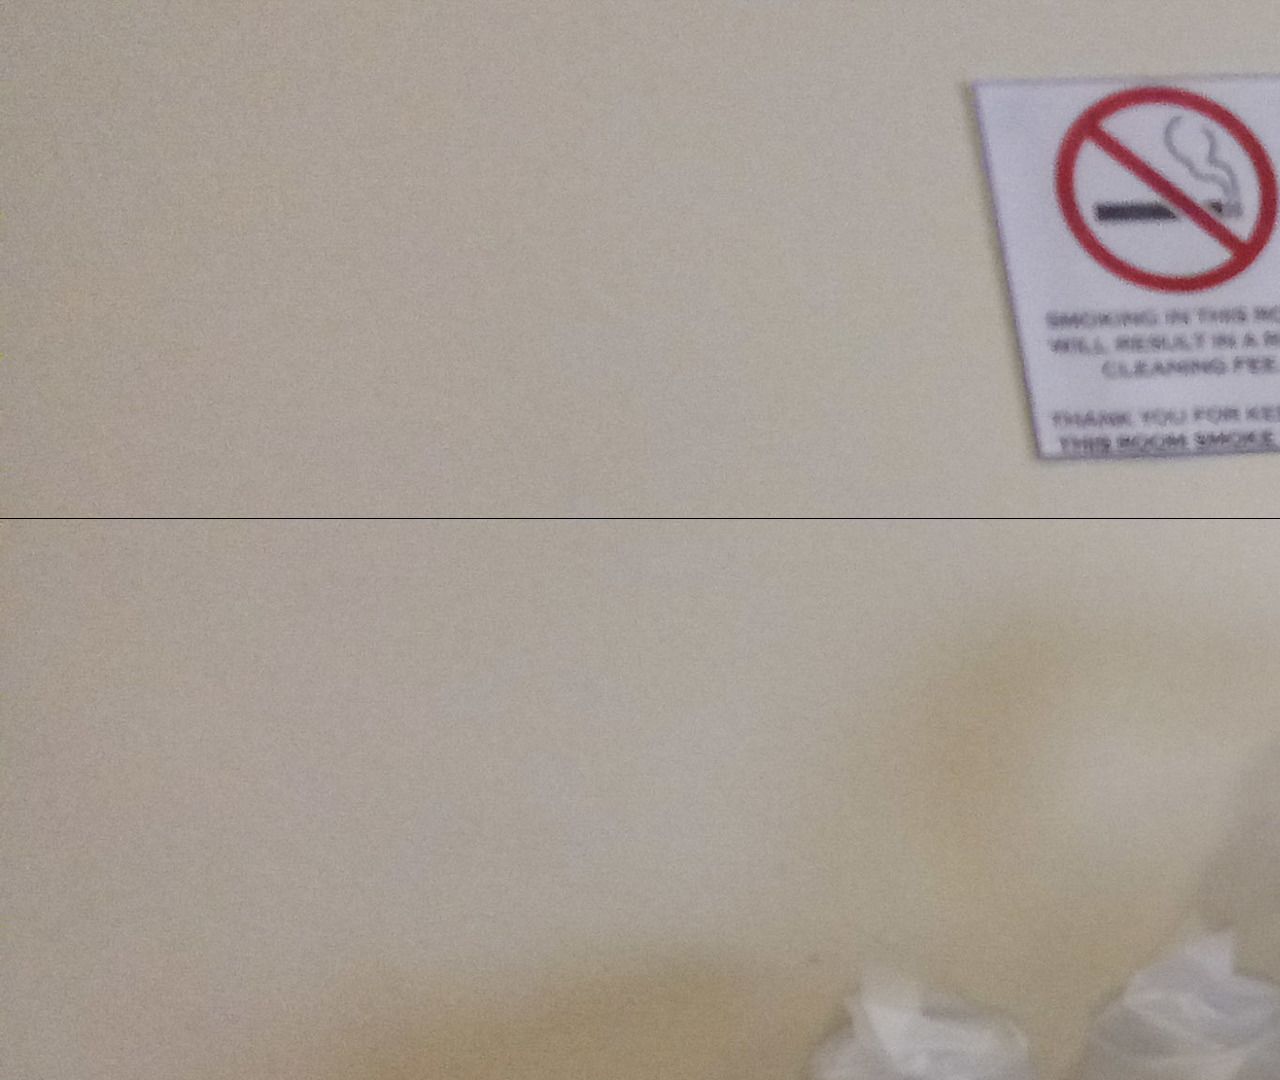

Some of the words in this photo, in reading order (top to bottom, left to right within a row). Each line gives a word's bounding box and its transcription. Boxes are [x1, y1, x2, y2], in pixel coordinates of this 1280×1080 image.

[1045, 309, 1157, 328] SMOKING
[1164, 308, 1191, 325] IN
[1196, 306, 1247, 324] THIS
[1049, 334, 1105, 354] WILL
[1114, 331, 1206, 351] RESULT
[1212, 331, 1237, 348] IN
[1242, 330, 1257, 347] A
[1101, 357, 1228, 380] CLEANING
[1050, 407, 1132, 427] THANK
[1140, 407, 1187, 425] YOU
[1191, 405, 1241, 423] FOR
[1058, 434, 1112, 451] THIS
[1115, 431, 1187, 448] ROOM
[1193, 428, 1275, 447] SMOKE
